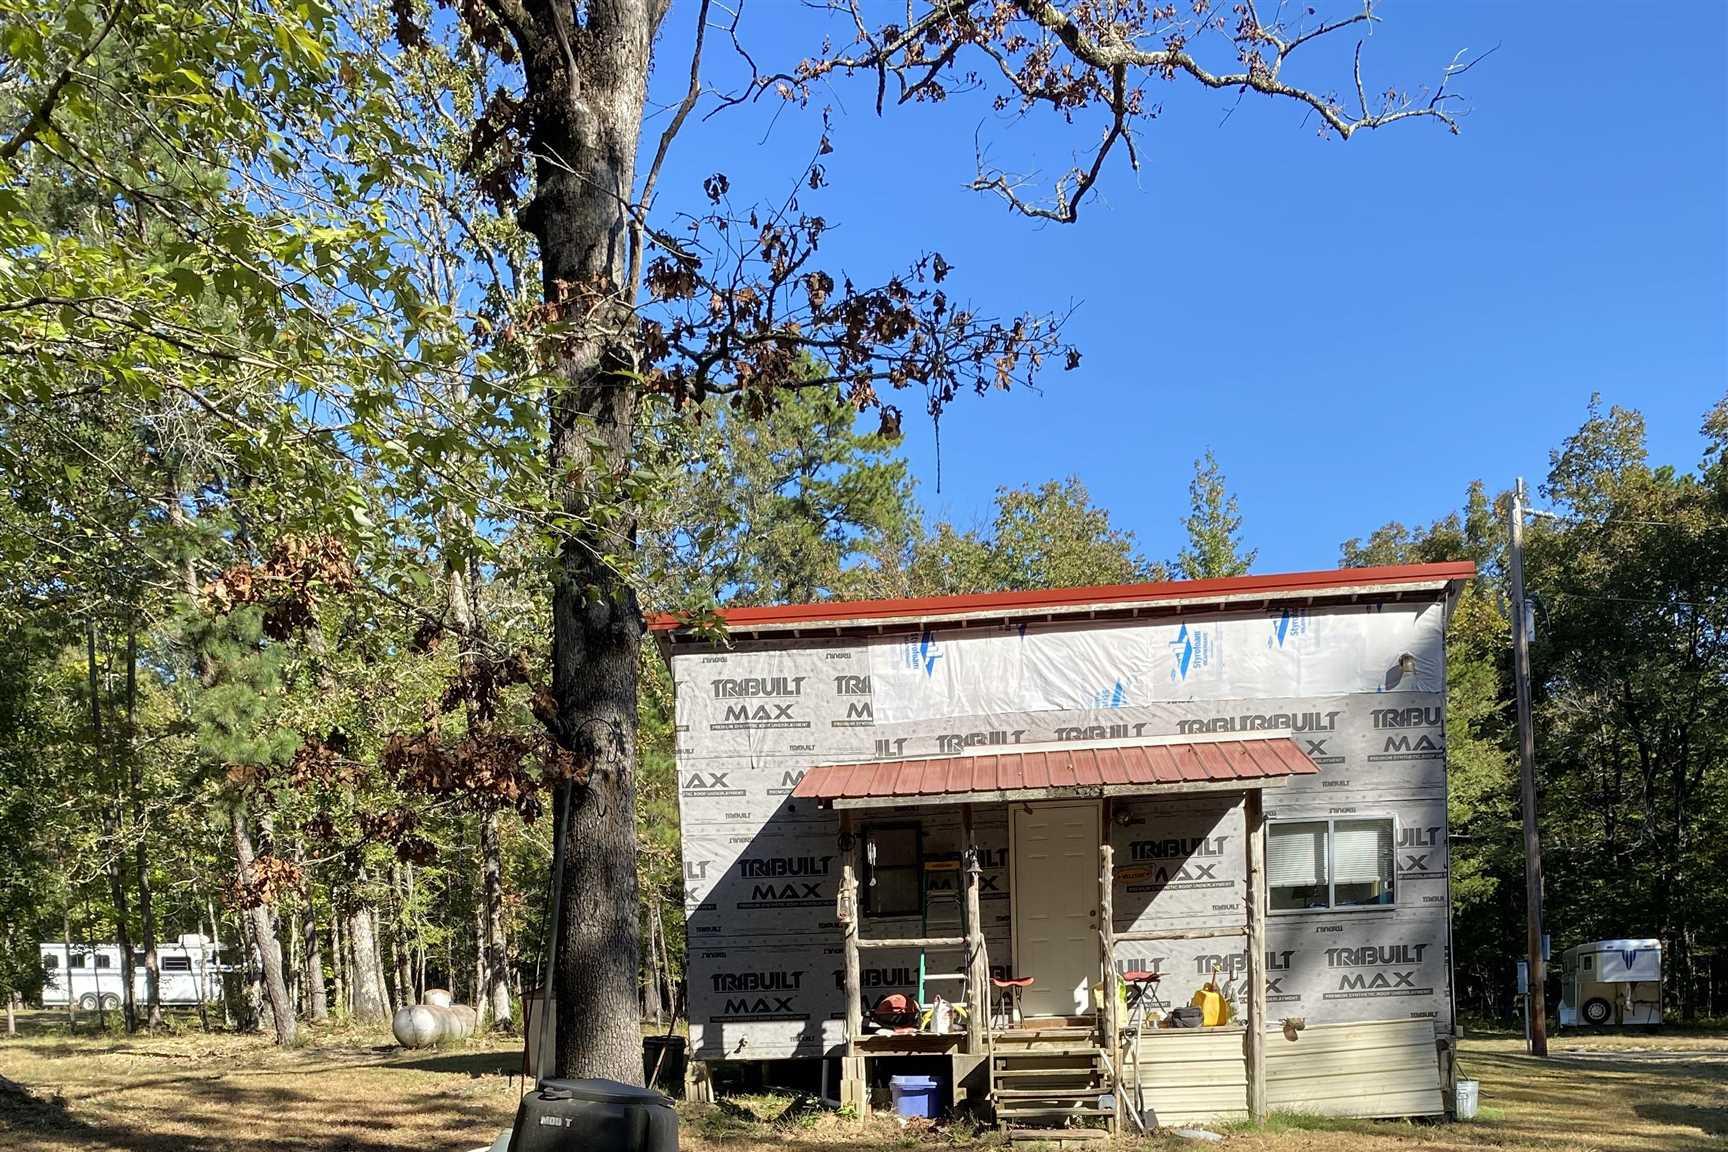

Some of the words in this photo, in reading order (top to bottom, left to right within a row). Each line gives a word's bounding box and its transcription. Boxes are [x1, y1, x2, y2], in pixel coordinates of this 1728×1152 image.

[725, 704, 794, 721] MAX
[752, 883, 821, 900] MAX
[1324, 944, 1431, 967] TRIBUILT
[711, 972, 806, 991] TRIBUILT
[1339, 971, 1415, 990] MAX
[725, 998, 793, 1014] MAX
